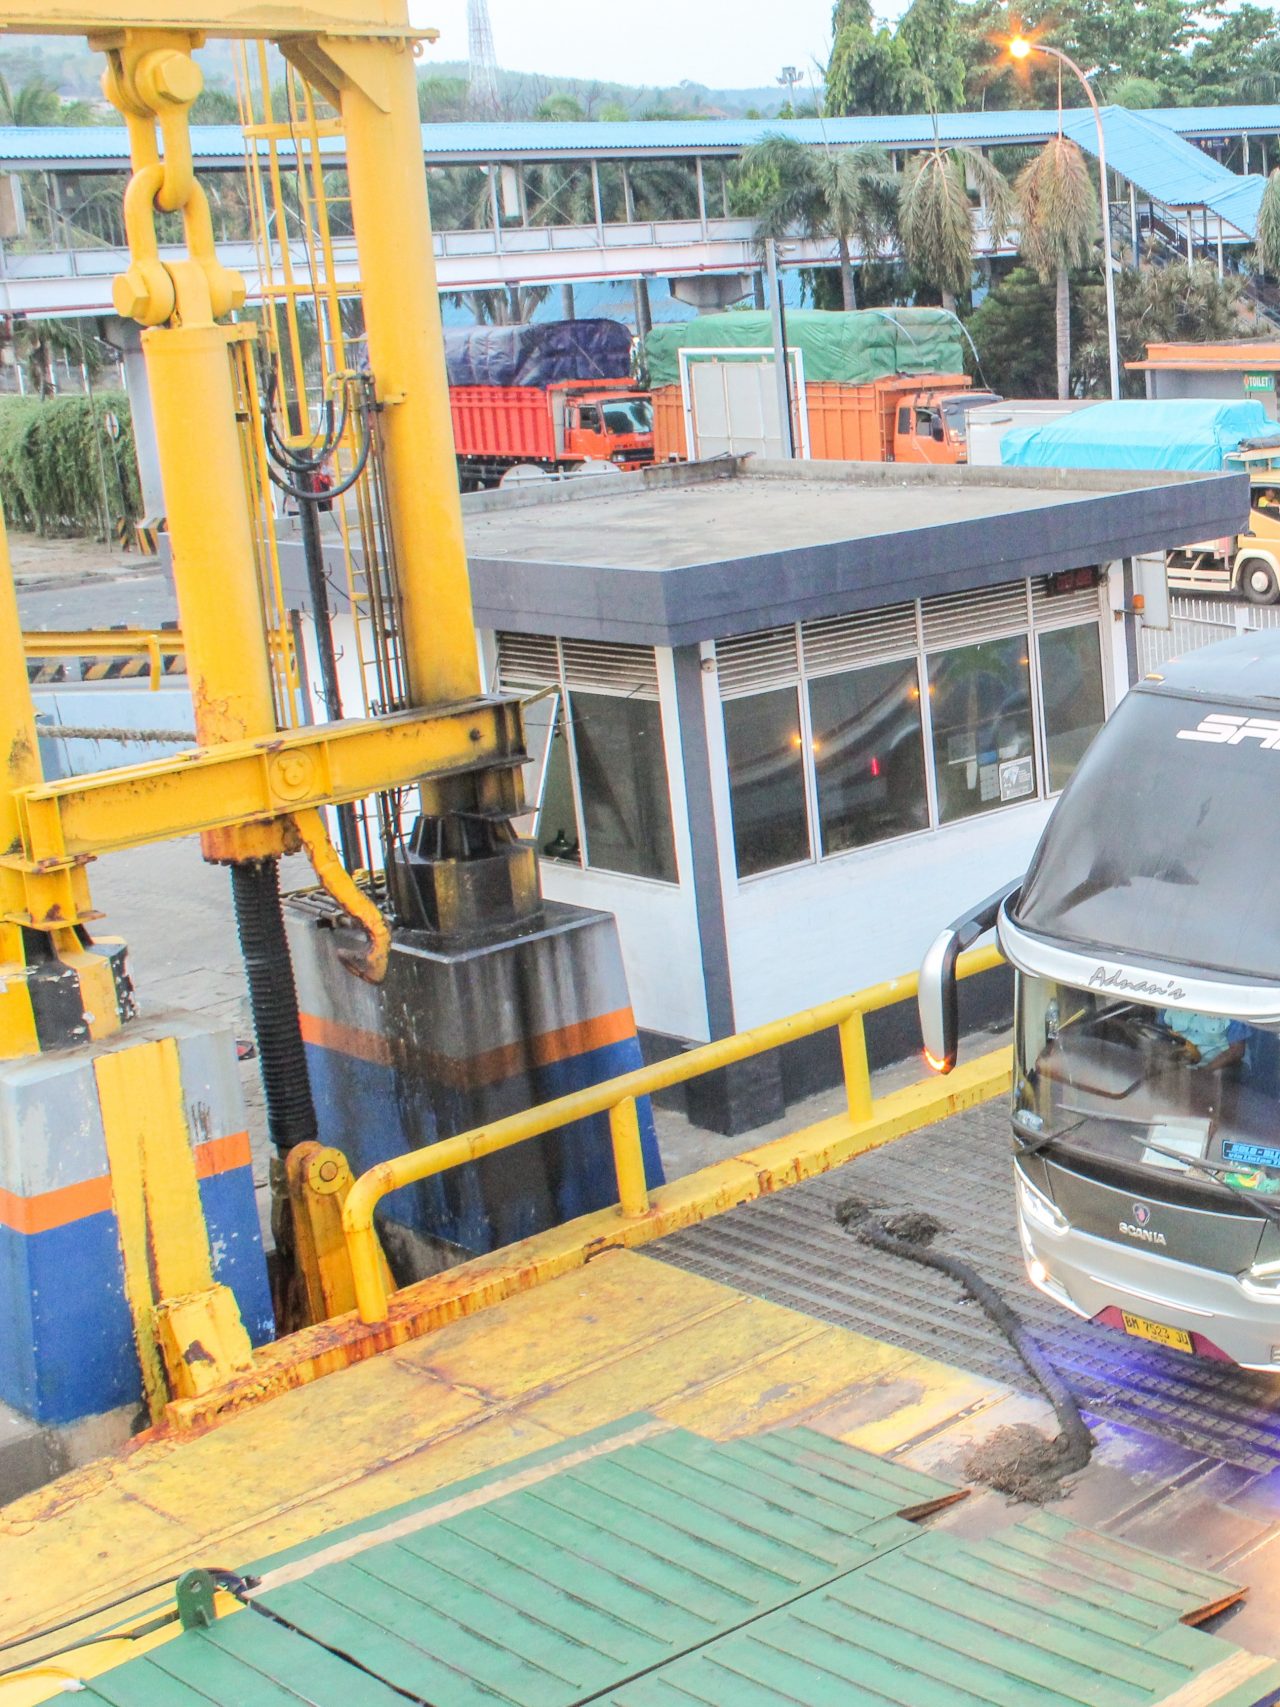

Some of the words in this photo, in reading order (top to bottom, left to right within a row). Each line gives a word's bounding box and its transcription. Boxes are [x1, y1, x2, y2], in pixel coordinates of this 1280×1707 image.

[1249, 375, 1268, 387] TOILET
[1088, 966, 1187, 1000] Adnan's
[1119, 1221, 1167, 1246] SCANIA
[1125, 1315, 1140, 1330] BM
[1142, 1321, 1170, 1339] 7523
